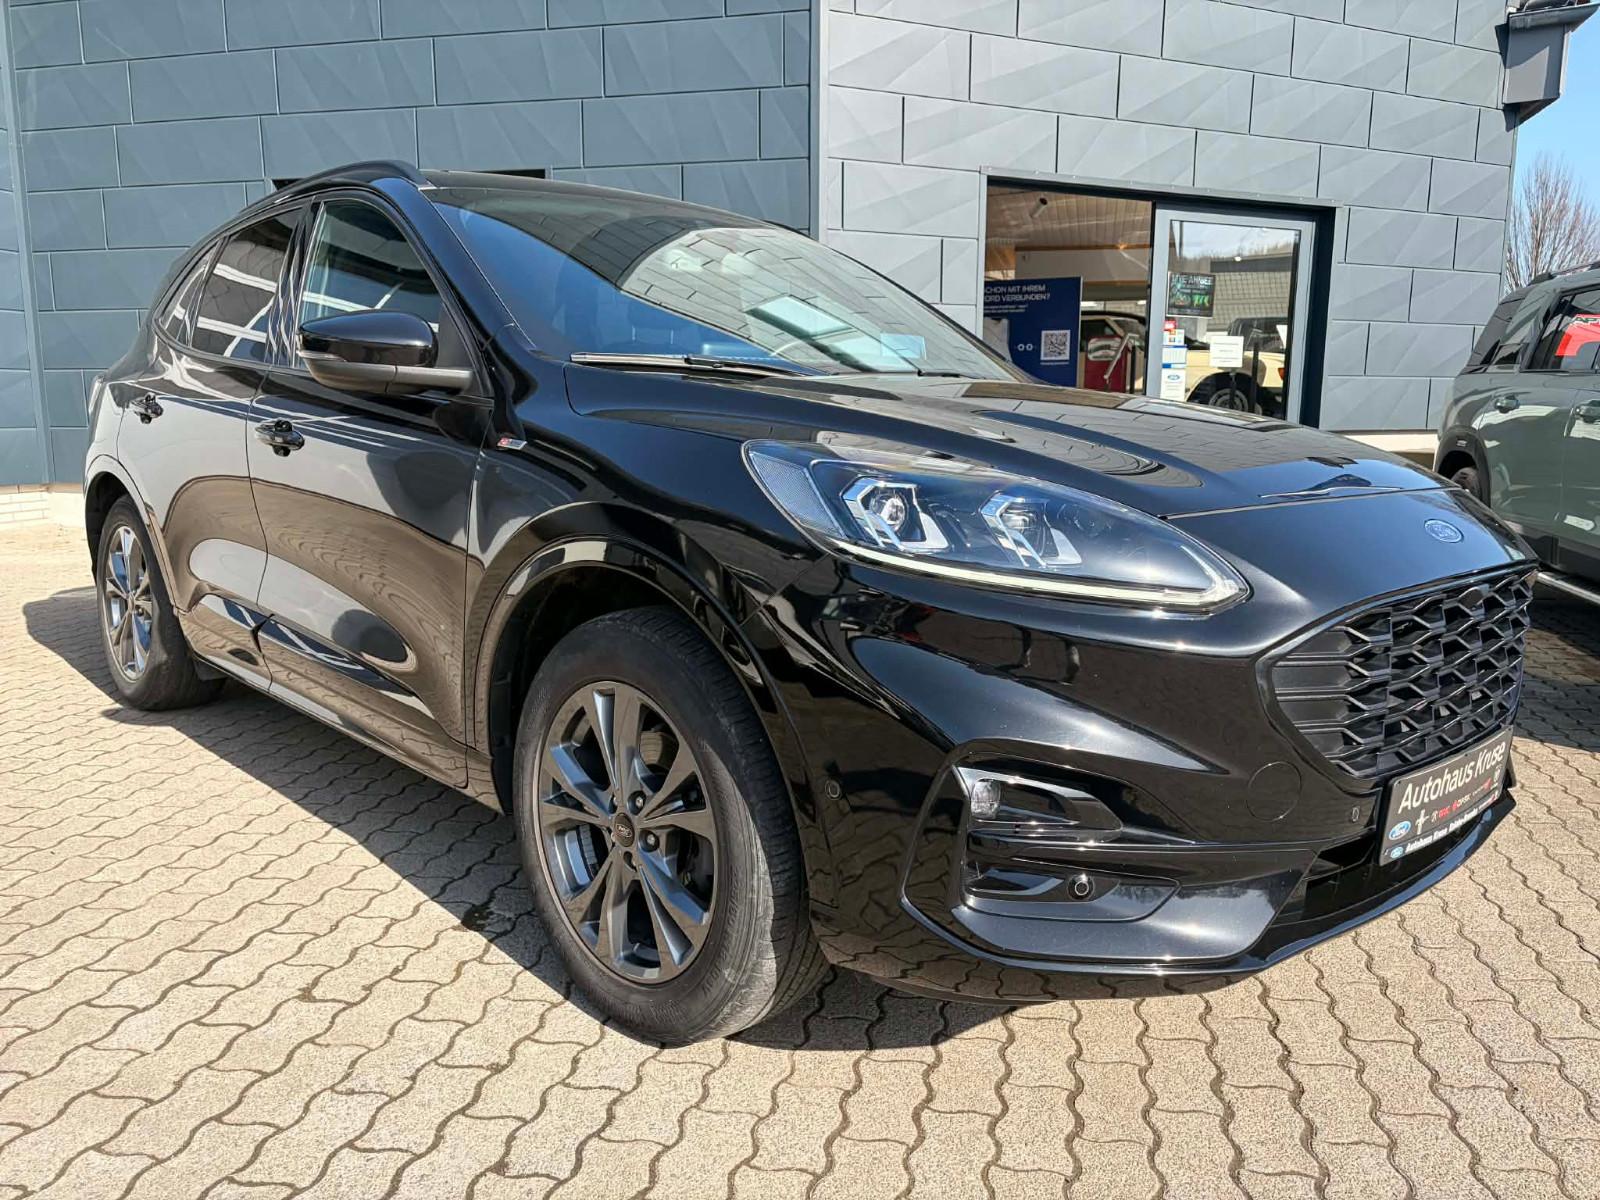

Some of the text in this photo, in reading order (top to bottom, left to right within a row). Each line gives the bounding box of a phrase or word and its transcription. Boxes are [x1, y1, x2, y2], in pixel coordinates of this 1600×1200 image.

[1007, 285, 1020, 293] MIT
[1022, 284, 1045, 292] IHREM
[1002, 293, 1050, 302] VERBUNDEN?
[1398, 761, 1475, 814] Autohaus
[1474, 741, 1506, 779] Kruse
